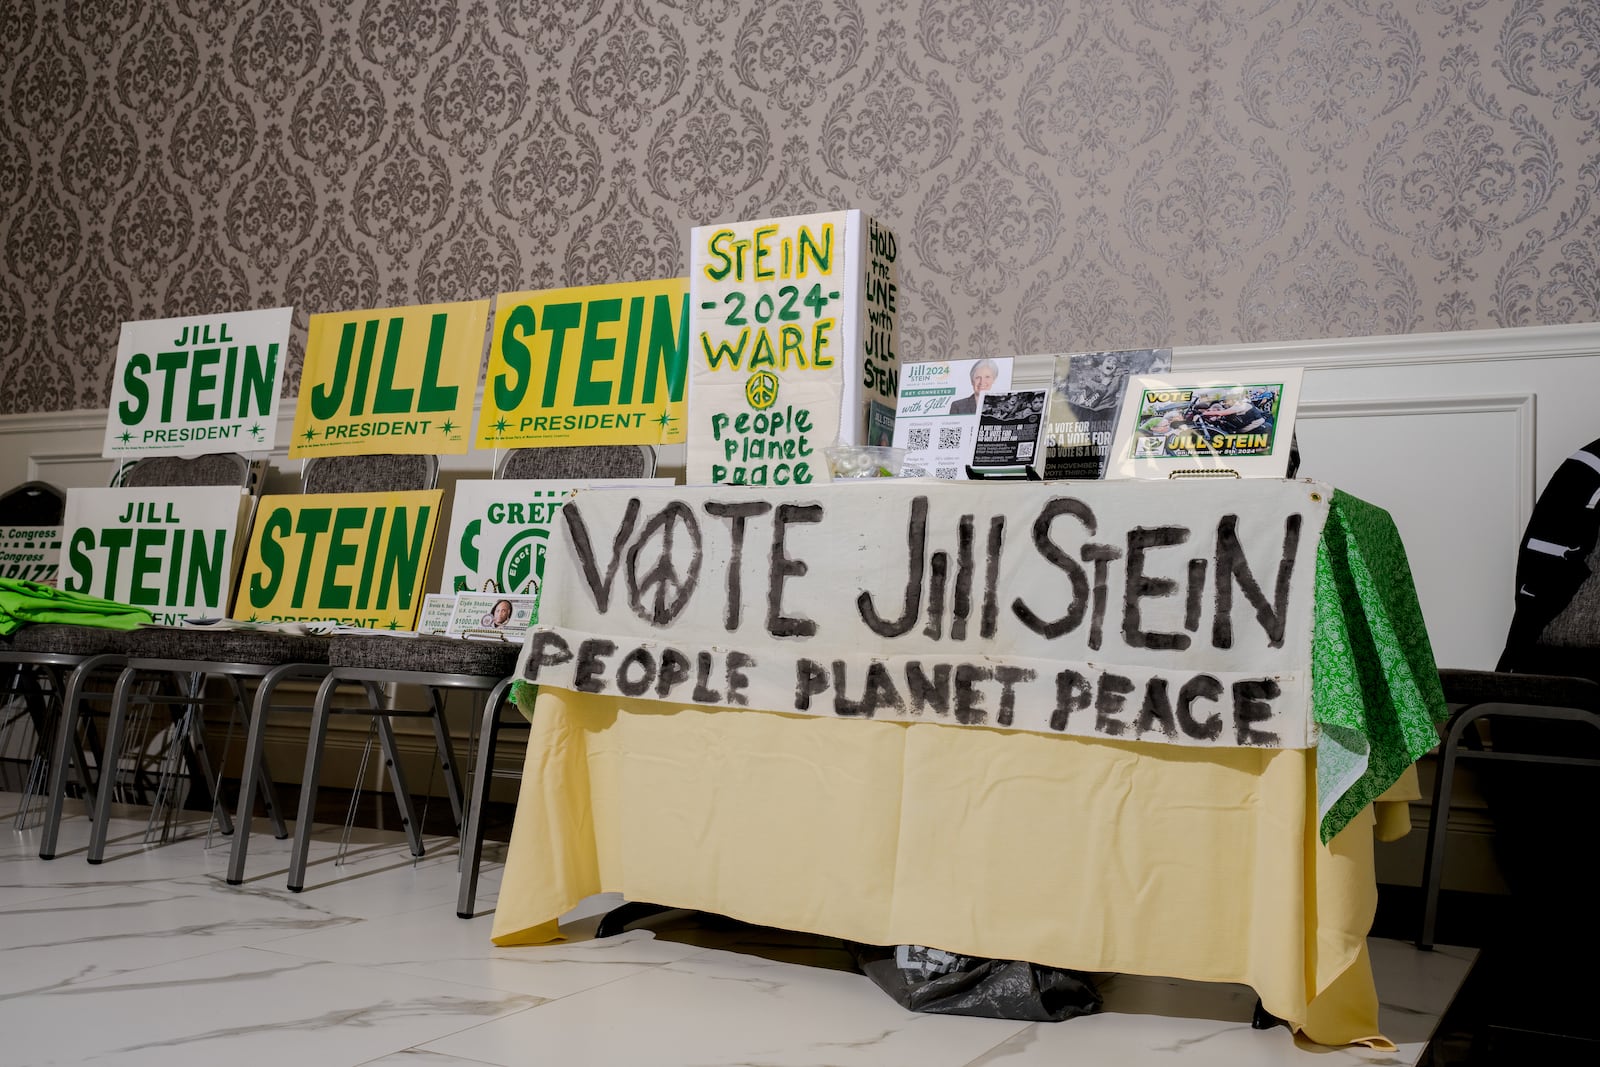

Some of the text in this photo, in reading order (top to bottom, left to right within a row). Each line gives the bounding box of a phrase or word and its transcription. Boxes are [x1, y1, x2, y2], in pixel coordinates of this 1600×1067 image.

[870, 218, 896, 262] HOLD
[703, 223, 834, 282] STEIN
[872, 258, 890, 280] the
[866, 272, 896, 313] LINE
[868, 308, 892, 331] with
[174, 323, 234, 346] JILL
[701, 318, 836, 371] WARE
[866, 326, 894, 361] JILL
[494, 292, 690, 412] STEIN
[311, 313, 460, 420] JILL
[864, 358, 897, 398] STEIN
[908, 365, 950, 378] Jill 2024
[118, 342, 280, 426] STEIN
[902, 400, 922, 414] with
[1146, 391, 1193, 403] VOTE
[143, 425, 242, 442] PRESIDENT
[325, 420, 432, 440] PRESIDENT
[520, 412, 646, 432] PRESIDENT
[712, 406, 814, 441] people
[1048, 423, 1054, 434] A
[1055, 422, 1074, 433] VOTE
[1074, 421, 1090, 432] FOR
[724, 436, 814, 462] planet
[1044, 434, 1056, 447] IS
[1058, 434, 1065, 446] A
[1067, 432, 1090, 445] VOTE
[1092, 432, 1111, 446] FOR
[1168, 434, 1269, 450] JILL STEIN
[1058, 447, 1075, 458] VOTE
[1076, 446, 1084, 457] IS
[1084, 446, 1090, 456] A
[712, 462, 814, 486] peace
[118, 502, 180, 524] JILL
[8, 528, 56, 540] Congress
[64, 527, 226, 608] STEIN
[249, 505, 431, 610] STEIN
[562, 498, 824, 637] VOTE
[1011, 497, 1302, 650] STEIN
[524, 630, 1282, 746] PEOPLE PLANET PEACE
